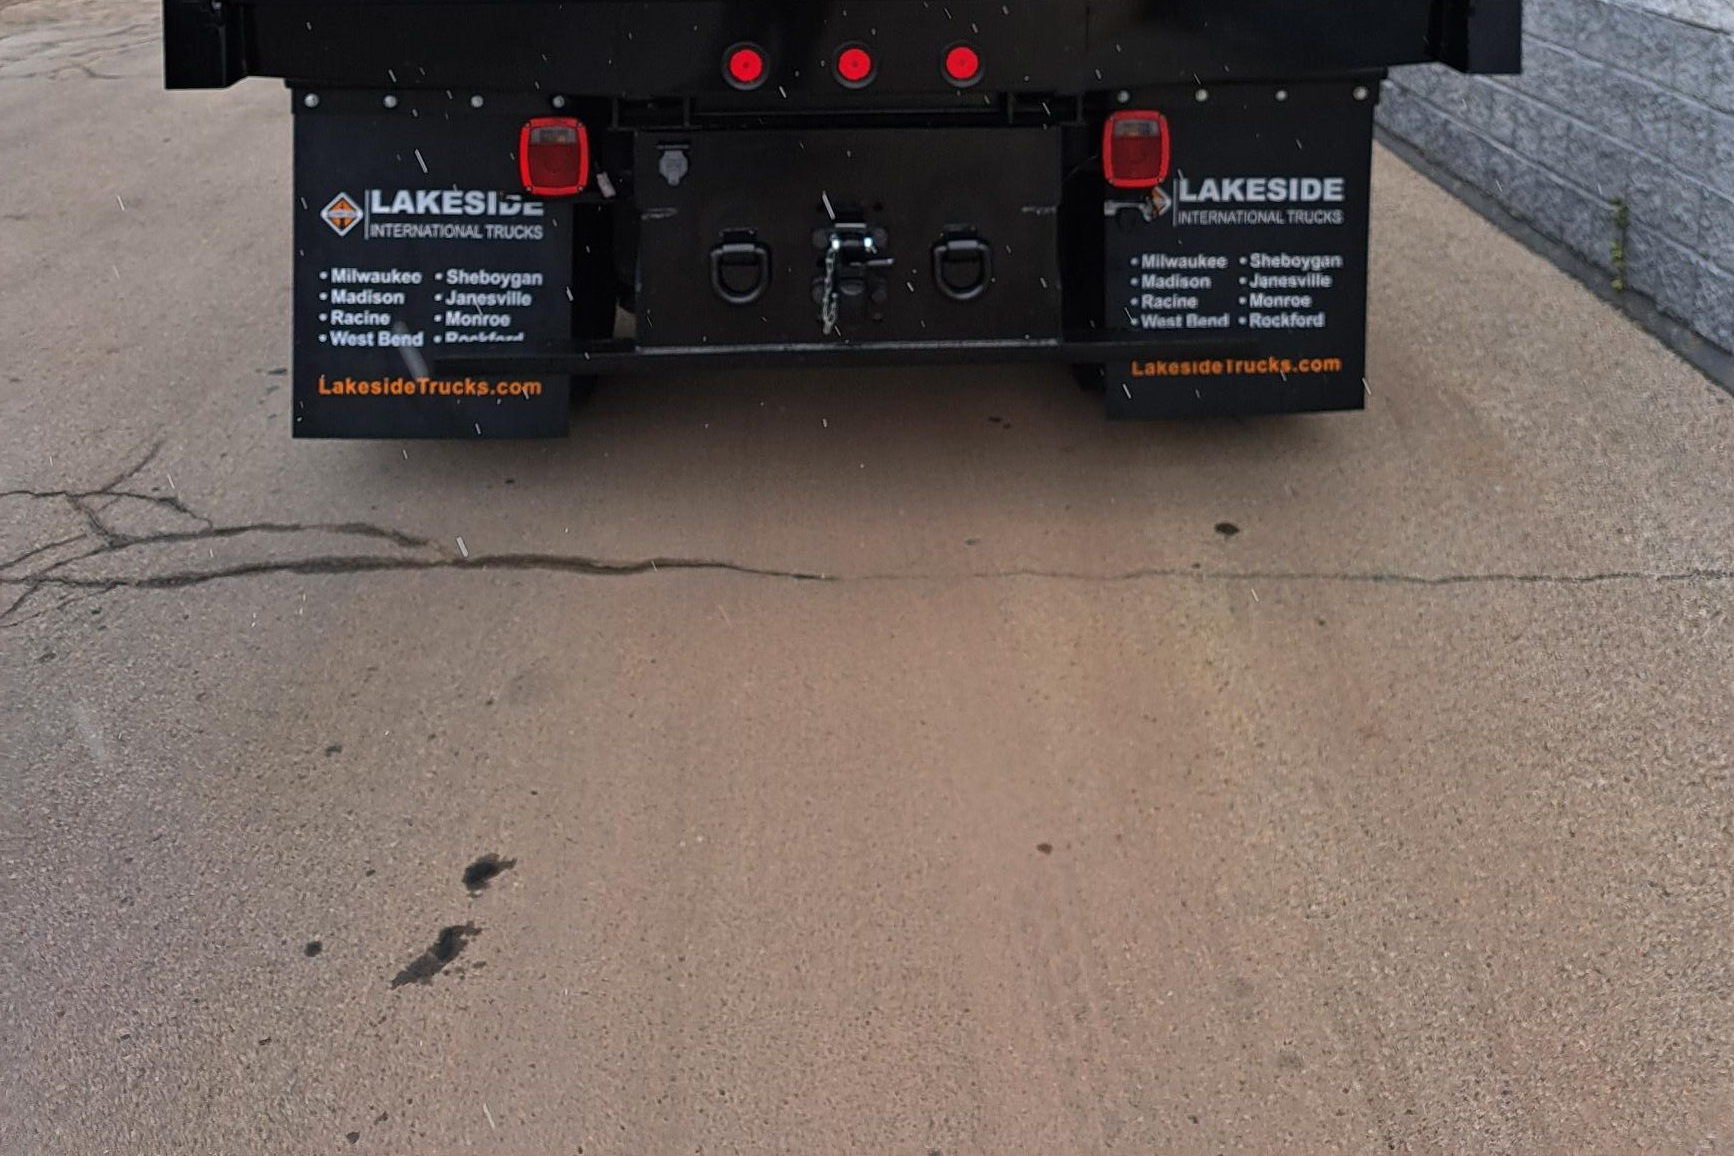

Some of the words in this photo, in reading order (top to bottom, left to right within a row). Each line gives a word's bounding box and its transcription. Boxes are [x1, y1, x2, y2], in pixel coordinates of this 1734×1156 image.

[1179, 178, 1345, 202] LAKESIDE
[370, 189, 545, 216] LAKESIDE
[1178, 210, 1285, 226] INTERNATIONAL
[1286, 210, 1344, 225] TRUCKS
[370, 223, 484, 240] INTERNATIONAL
[485, 224, 544, 240] TRUCKS
[1140, 253, 1228, 269] Milwaukee
[1249, 253, 1343, 271] Sheboygan
[330, 268, 422, 285] Milwaukee
[445, 269, 543, 287] Sheboygan
[1140, 273, 1212, 289] Madison
[1249, 273, 1332, 288] Janesville
[330, 289, 405, 305] Madison
[445, 291, 532, 307] Janesville
[1140, 294, 1198, 309] Racine
[1249, 293, 1312, 308] Monroe
[330, 310, 391, 326] Racine
[445, 312, 511, 327] Monroe
[1140, 313, 1182, 329] West
[1186, 313, 1230, 328] Bend
[1249, 312, 1325, 328] Rockford
[329, 330, 374, 347] West
[378, 331, 424, 347] Bend
[1131, 356, 1343, 377] LakesideTrucks.com
[318, 377, 542, 395] LakesideTrucks.com
